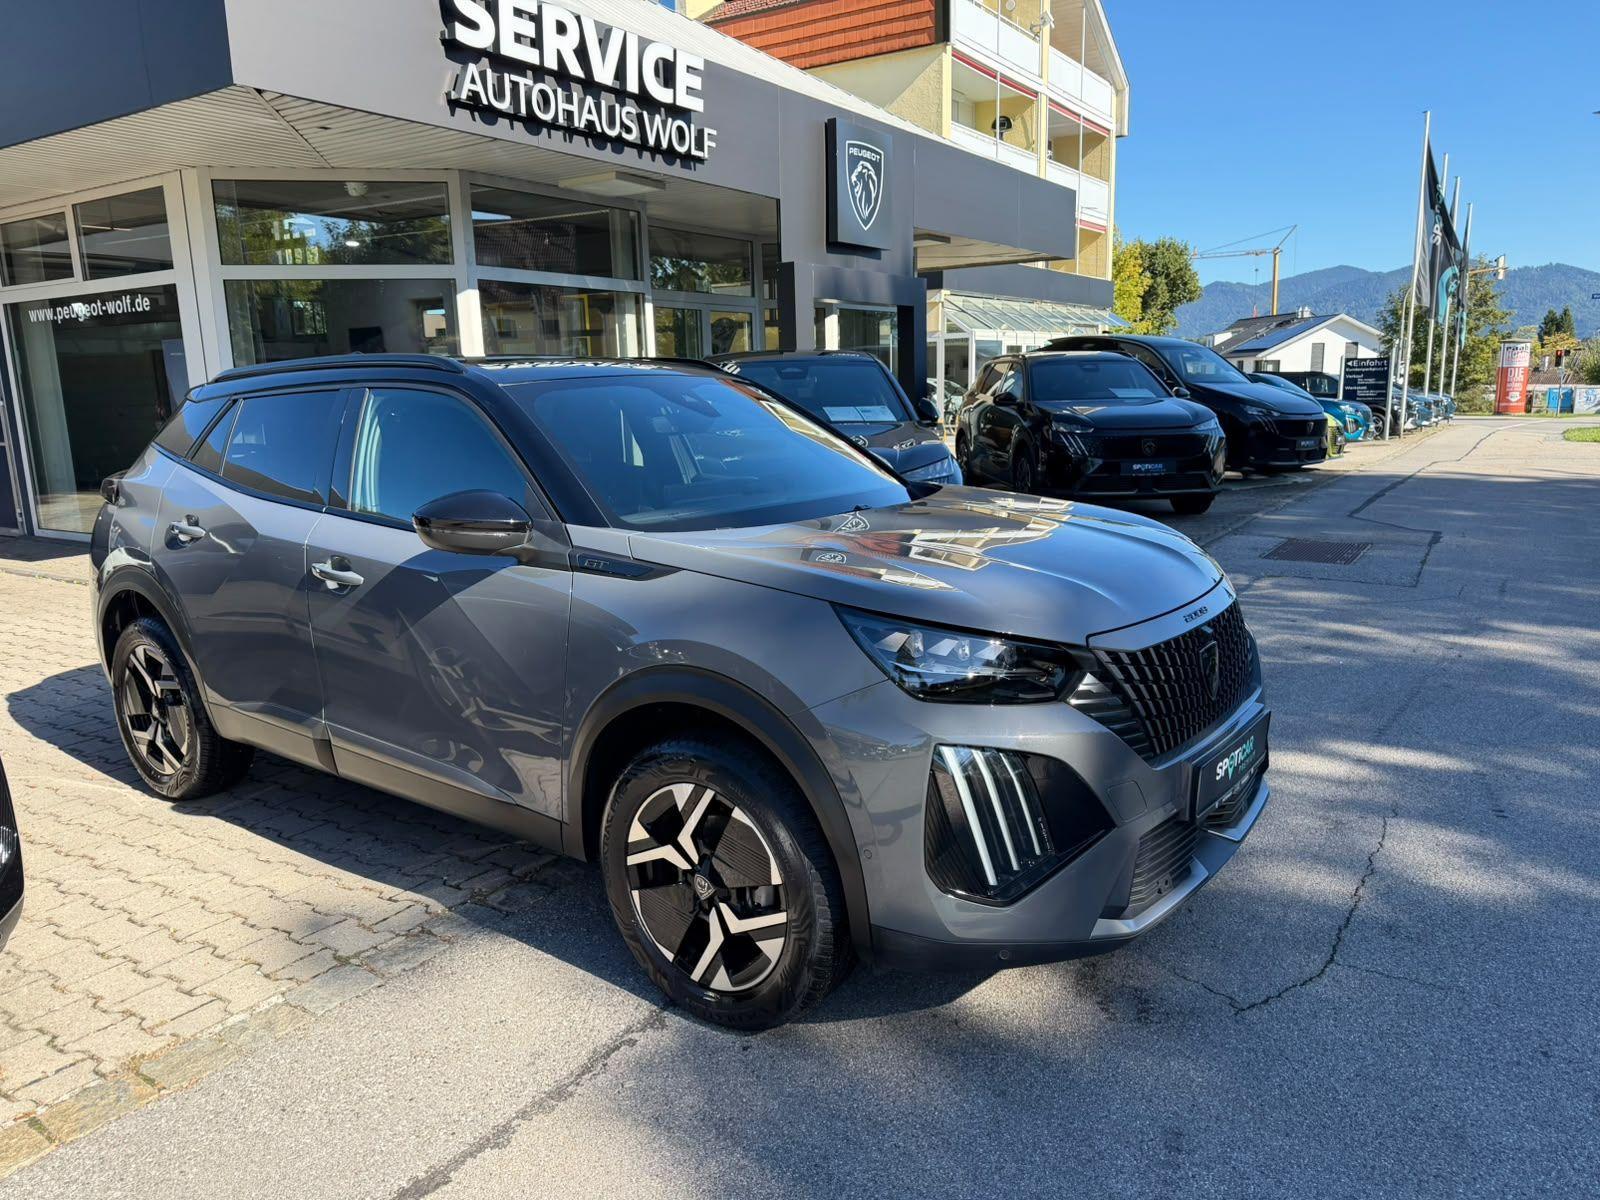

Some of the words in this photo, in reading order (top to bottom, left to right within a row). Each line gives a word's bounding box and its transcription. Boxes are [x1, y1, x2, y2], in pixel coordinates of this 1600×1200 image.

[453, 0, 704, 112] SERVICE
[460, 63, 637, 142] AUTOHAUS
[642, 111, 717, 159] WOLF
[849, 147, 880, 162] PEUGEOT
[28, 294, 151, 324] www.peugeot-wolf.de
[1353, 359, 1388, 367] Einfahrt
[1215, 735, 1255, 781] SPOTICAR
